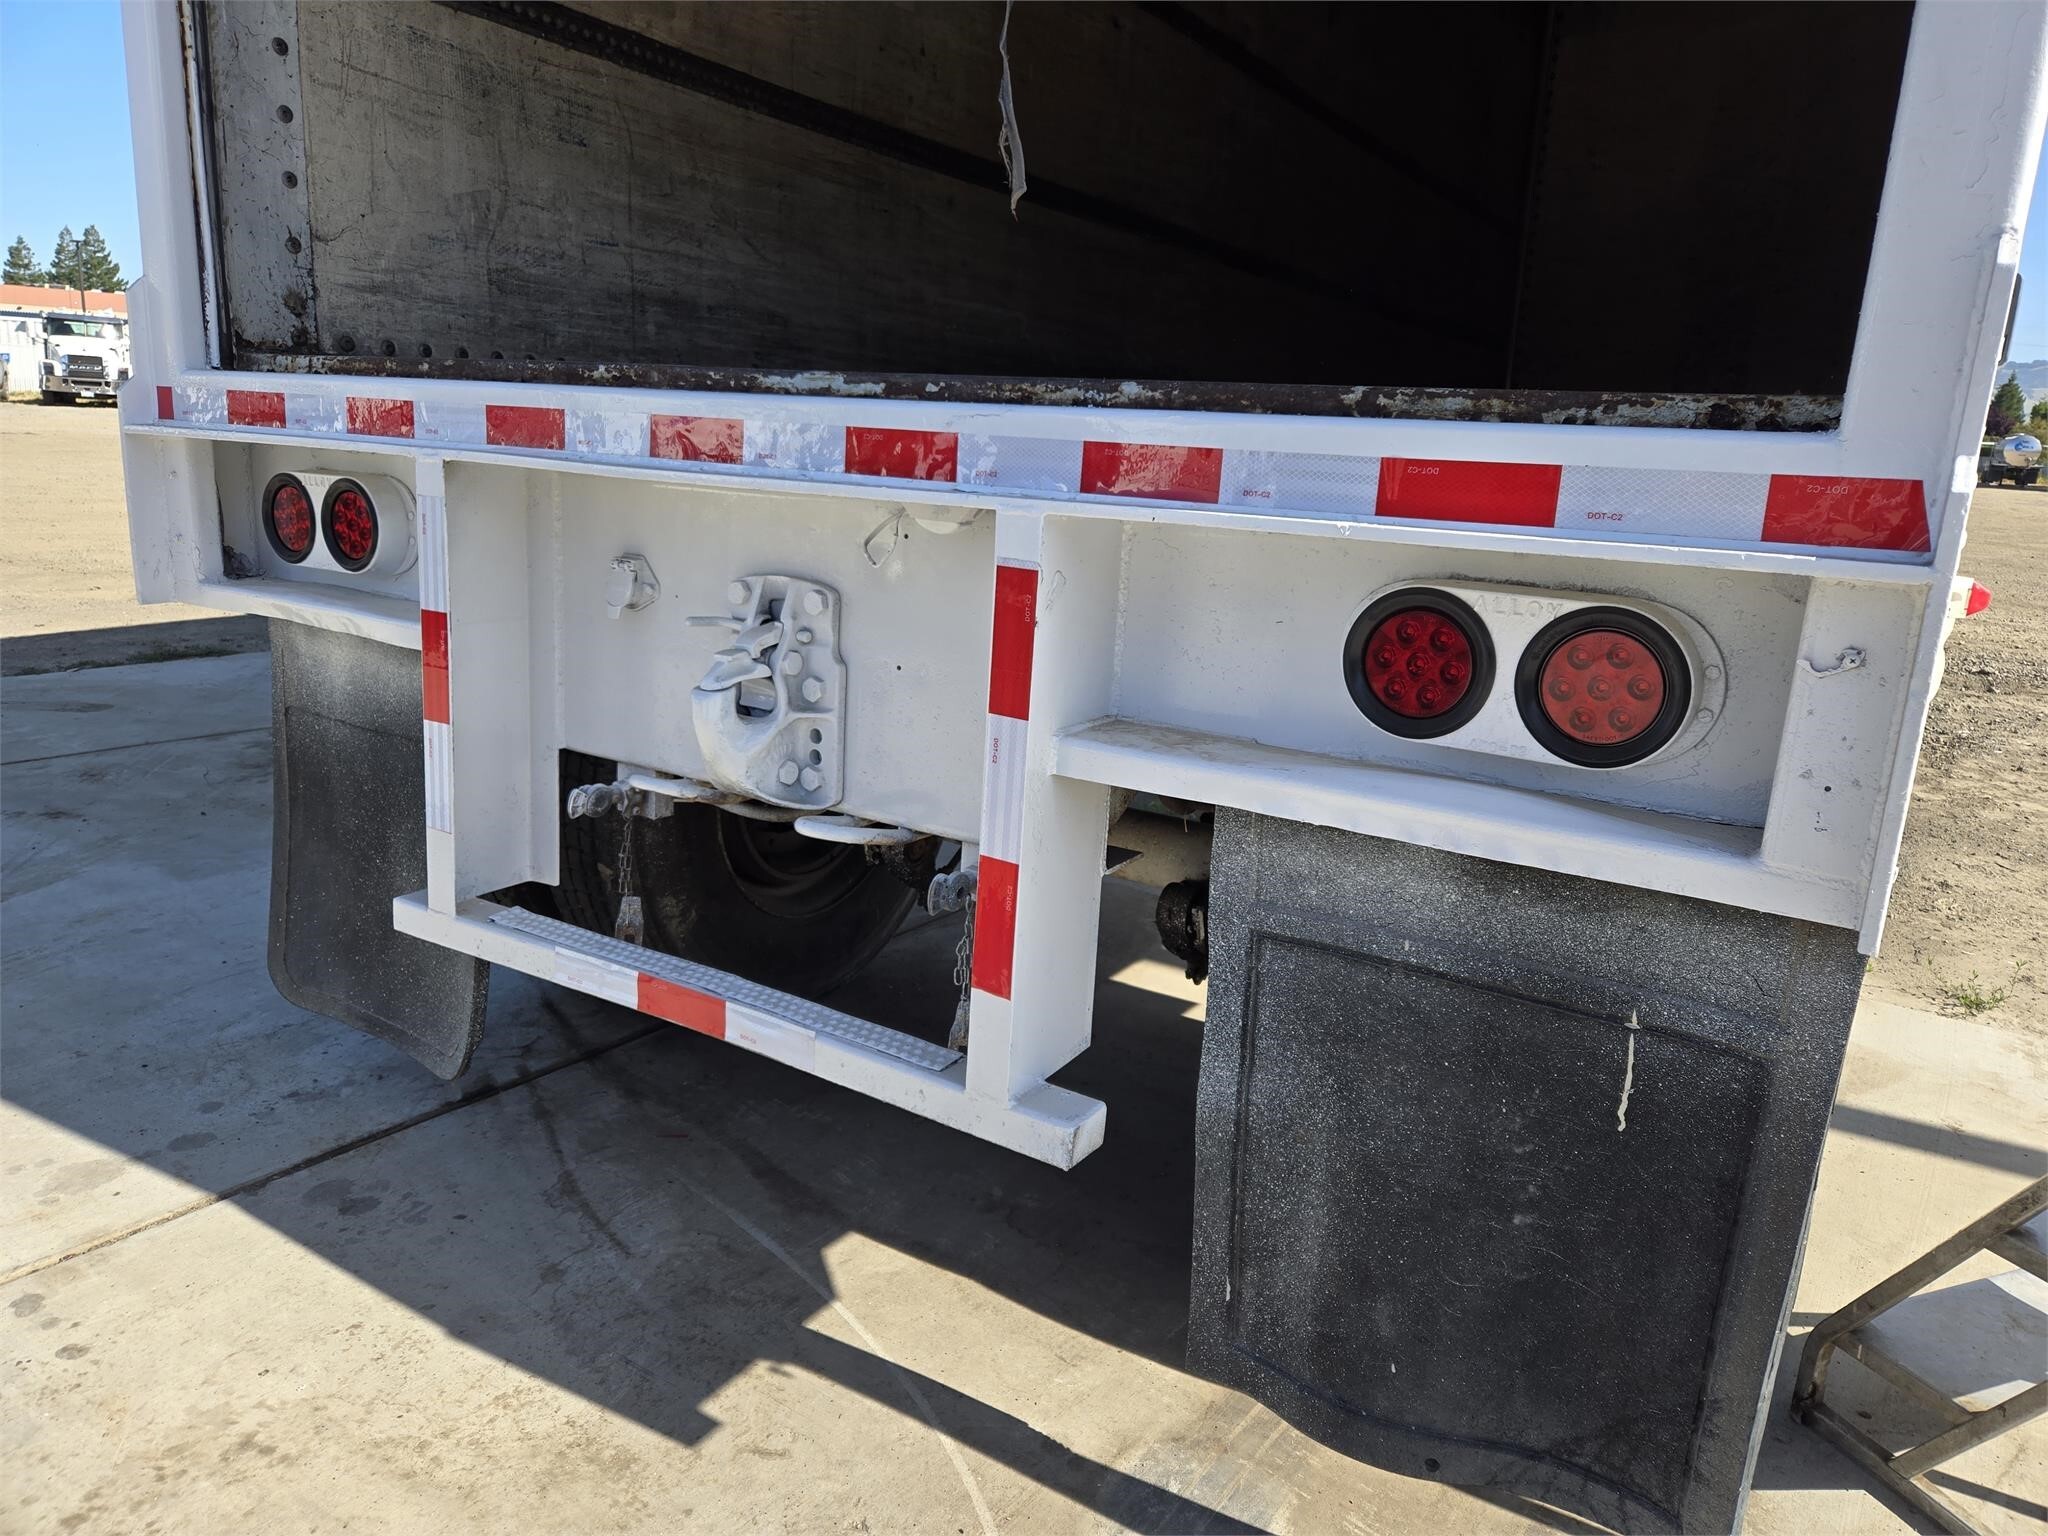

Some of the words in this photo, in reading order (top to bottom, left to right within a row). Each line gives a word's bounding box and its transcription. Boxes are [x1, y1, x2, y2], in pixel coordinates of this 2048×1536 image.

[1407, 466, 1440, 475] DOT-C2
[1242, 490, 1271, 498] DOT-C2
[1806, 485, 1849, 495] DOT-C2
[1587, 512, 1624, 521] DOT-C2
